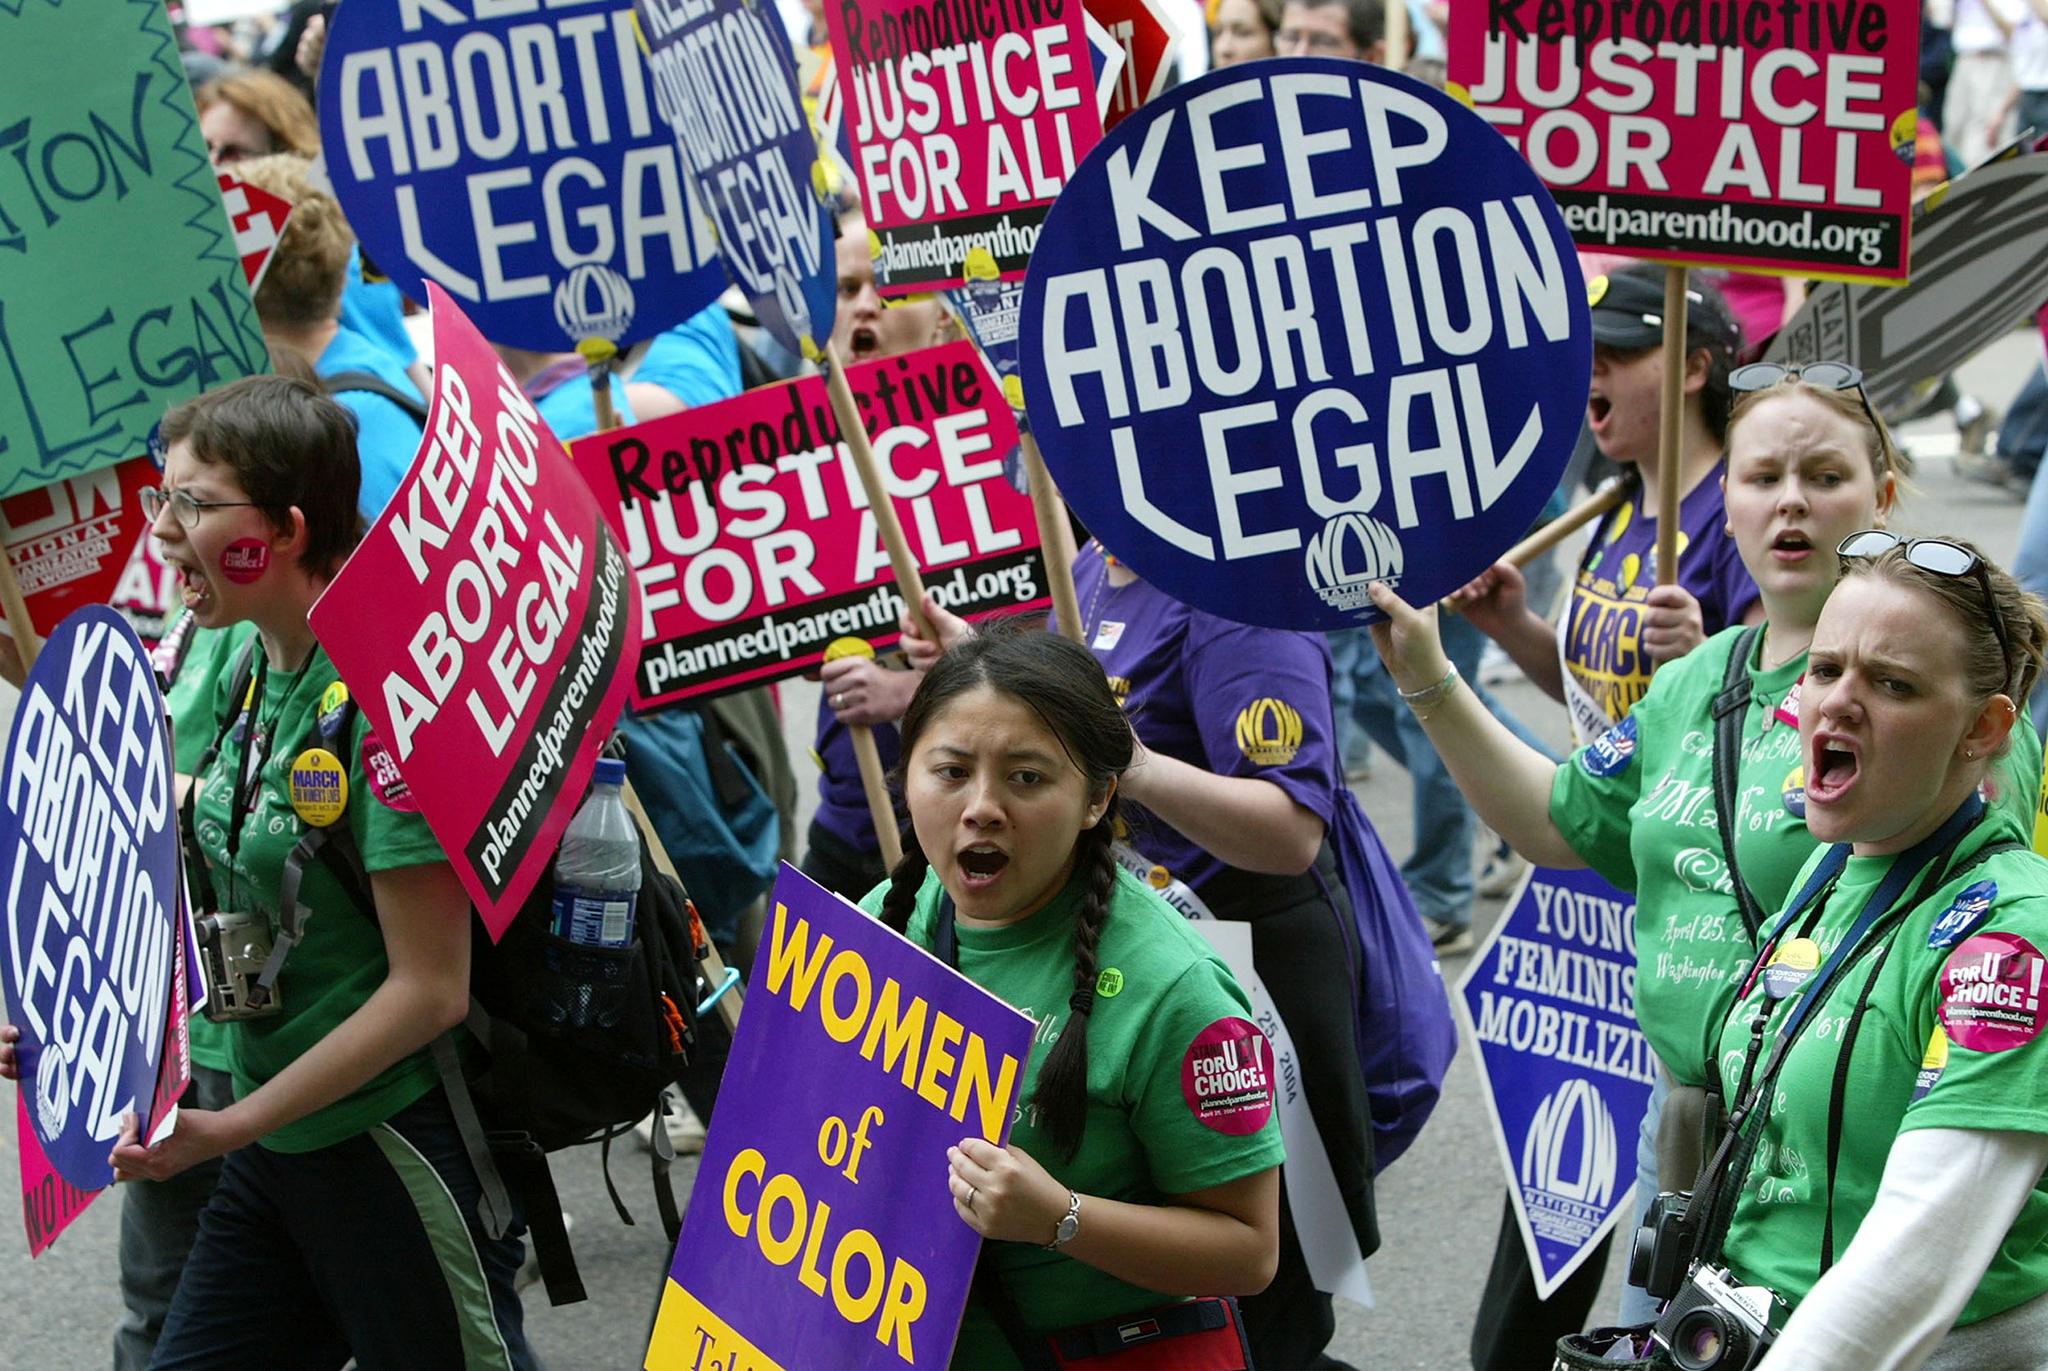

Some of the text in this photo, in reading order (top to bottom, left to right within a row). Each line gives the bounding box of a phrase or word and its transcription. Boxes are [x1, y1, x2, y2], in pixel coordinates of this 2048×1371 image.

[340, 9, 655, 182] ABORTI
[651, 8, 801, 176] ABORTION
[850, 24, 1081, 143] JUSTICE
[1469, 31, 1886, 131] JUSTICE
[701, 145, 821, 294] LEGAL
[860, 133, 969, 223] FOR
[1105, 73, 1449, 251] KEEP
[1702, 122, 1883, 208] ALL
[1042, 195, 1571, 427] ABORTION
[388, 363, 484, 586] KEEP
[608, 360, 982, 509] Reproductive
[620, 408, 1004, 571] JUSTICE
[1110, 363, 1544, 561] LEGAL
[381, 361, 541, 764] ABORTION
[634, 530, 825, 640] FOR
[1305, 513, 1404, 593] NOW
[466, 509, 585, 759] LEGAL
[644, 562, 1037, 695] plannedparenthod.org
[62, 621, 168, 847] KEEP
[293, 769, 340, 789] MARCH
[1235, 697, 1303, 750] NOW
[7, 682, 171, 1068] ABORTION
[6, 836, 138, 1143] LEGAL
[766, 901, 1019, 1146] WOMEN
[1493, 934, 1637, 1020] FEMINIS
[1655, 952, 1726, 986] Washington
[1193, 1056, 1226, 1077] FOR
[817, 1105, 884, 1184] of
[1521, 1079, 1618, 1209] NOW
[722, 1148, 928, 1365] COLOR
